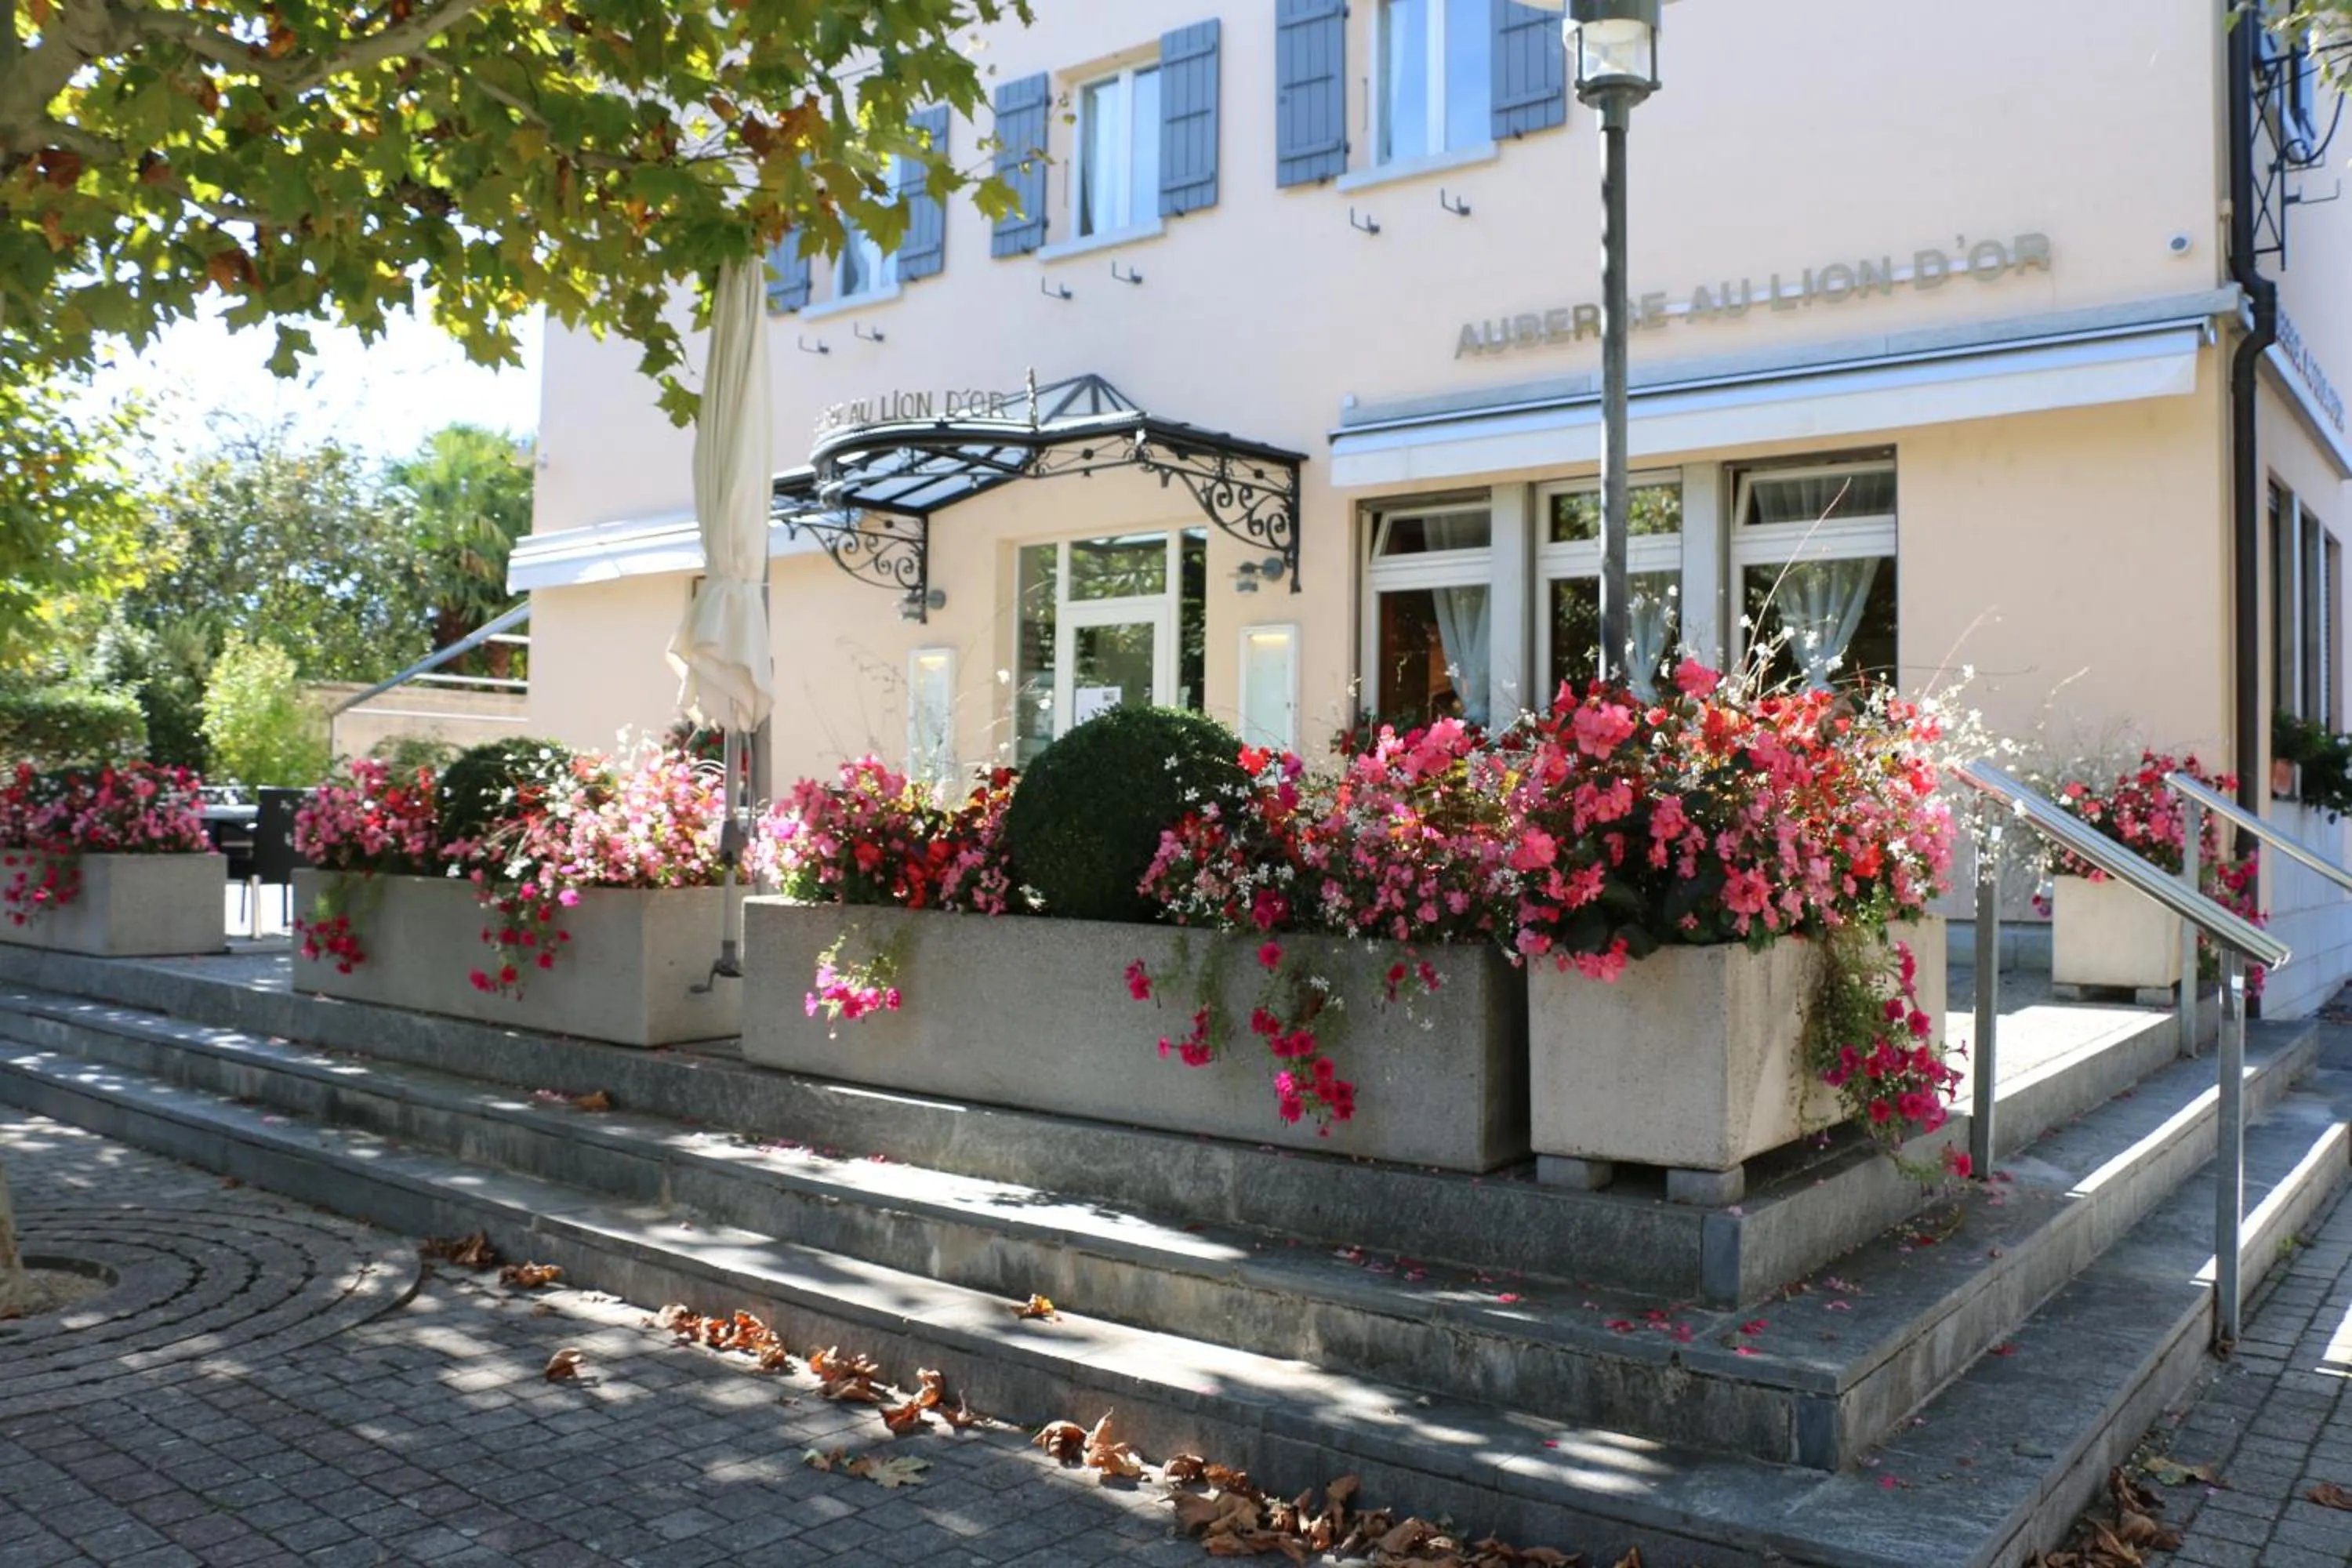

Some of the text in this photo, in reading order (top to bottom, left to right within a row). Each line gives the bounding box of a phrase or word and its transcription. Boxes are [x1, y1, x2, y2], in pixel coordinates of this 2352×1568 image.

[1454, 233, 2052, 360] AUBERE AU LION D'OR
[848, 398, 873, 424] AU
[880, 389, 933, 421] LION
[946, 388, 1007, 418] D'OR
